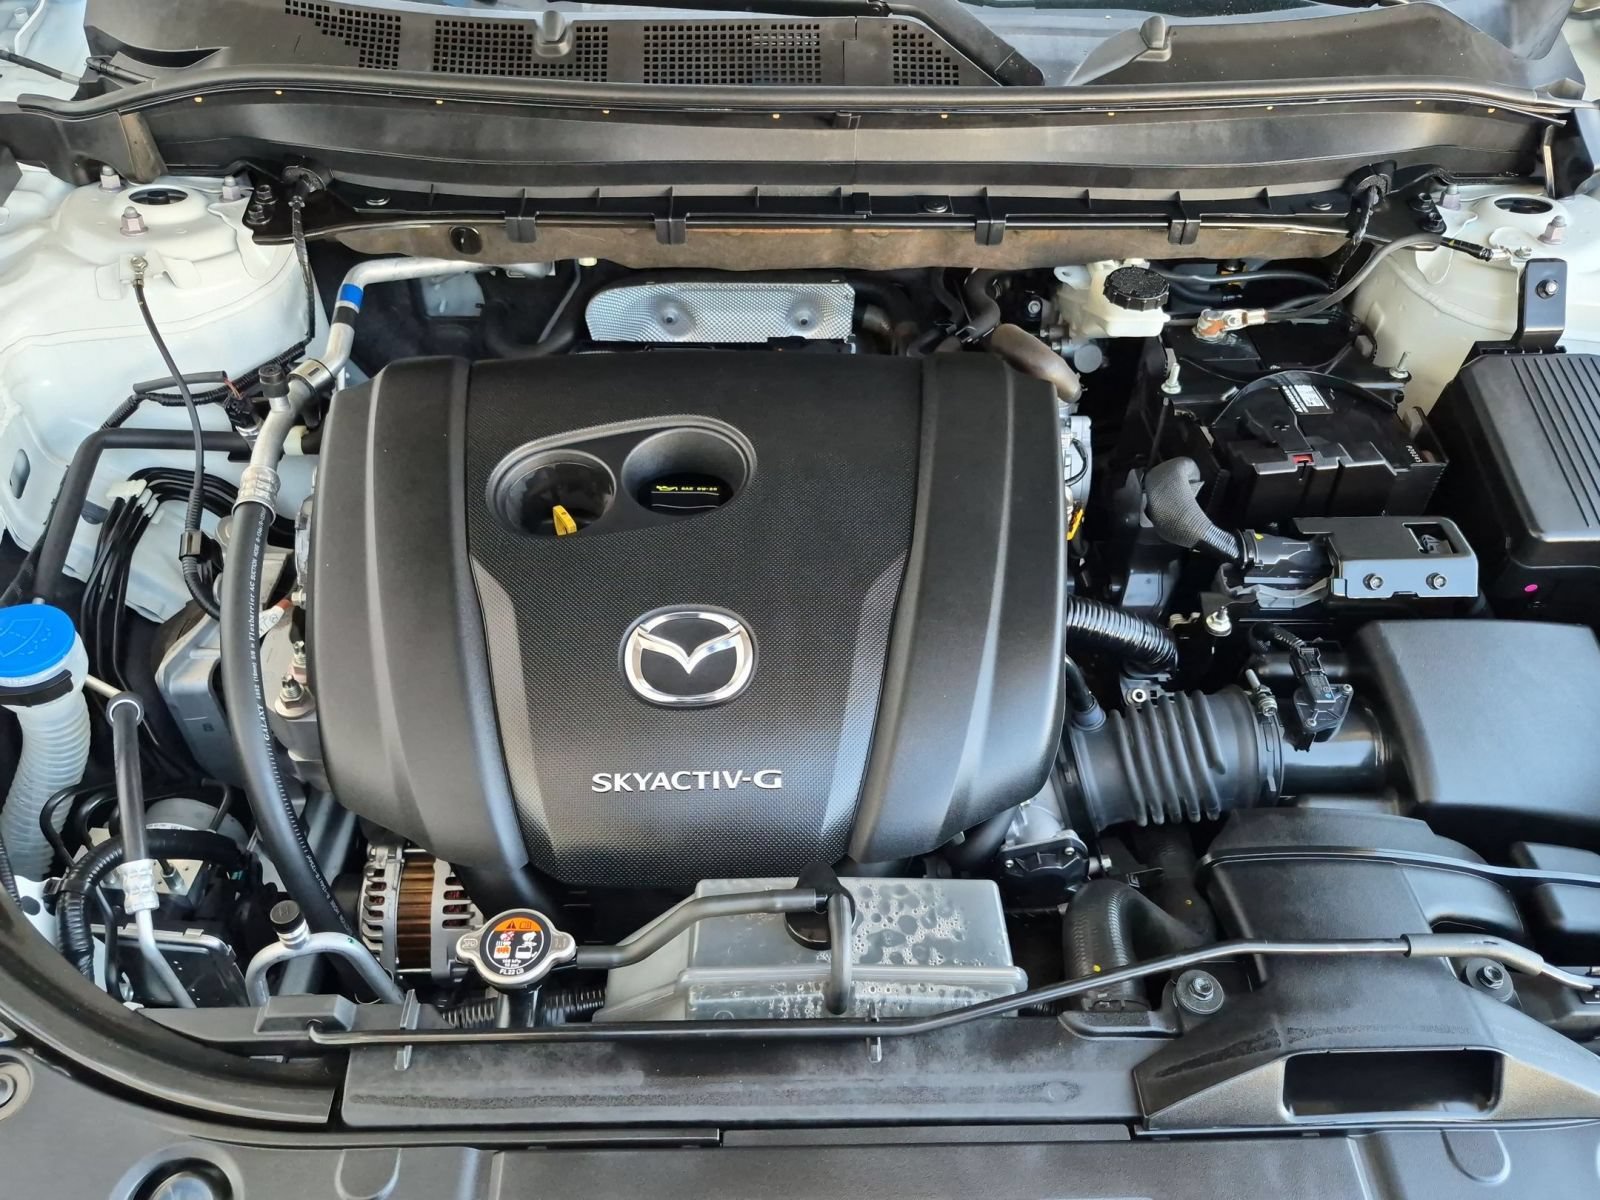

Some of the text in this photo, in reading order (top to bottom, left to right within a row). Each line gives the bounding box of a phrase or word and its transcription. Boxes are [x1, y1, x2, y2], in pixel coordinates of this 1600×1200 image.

[248, 594, 256, 641] Flexbarrier
[257, 704, 270, 741] GALAXY
[591, 769, 783, 793] SKYACTIV-G
